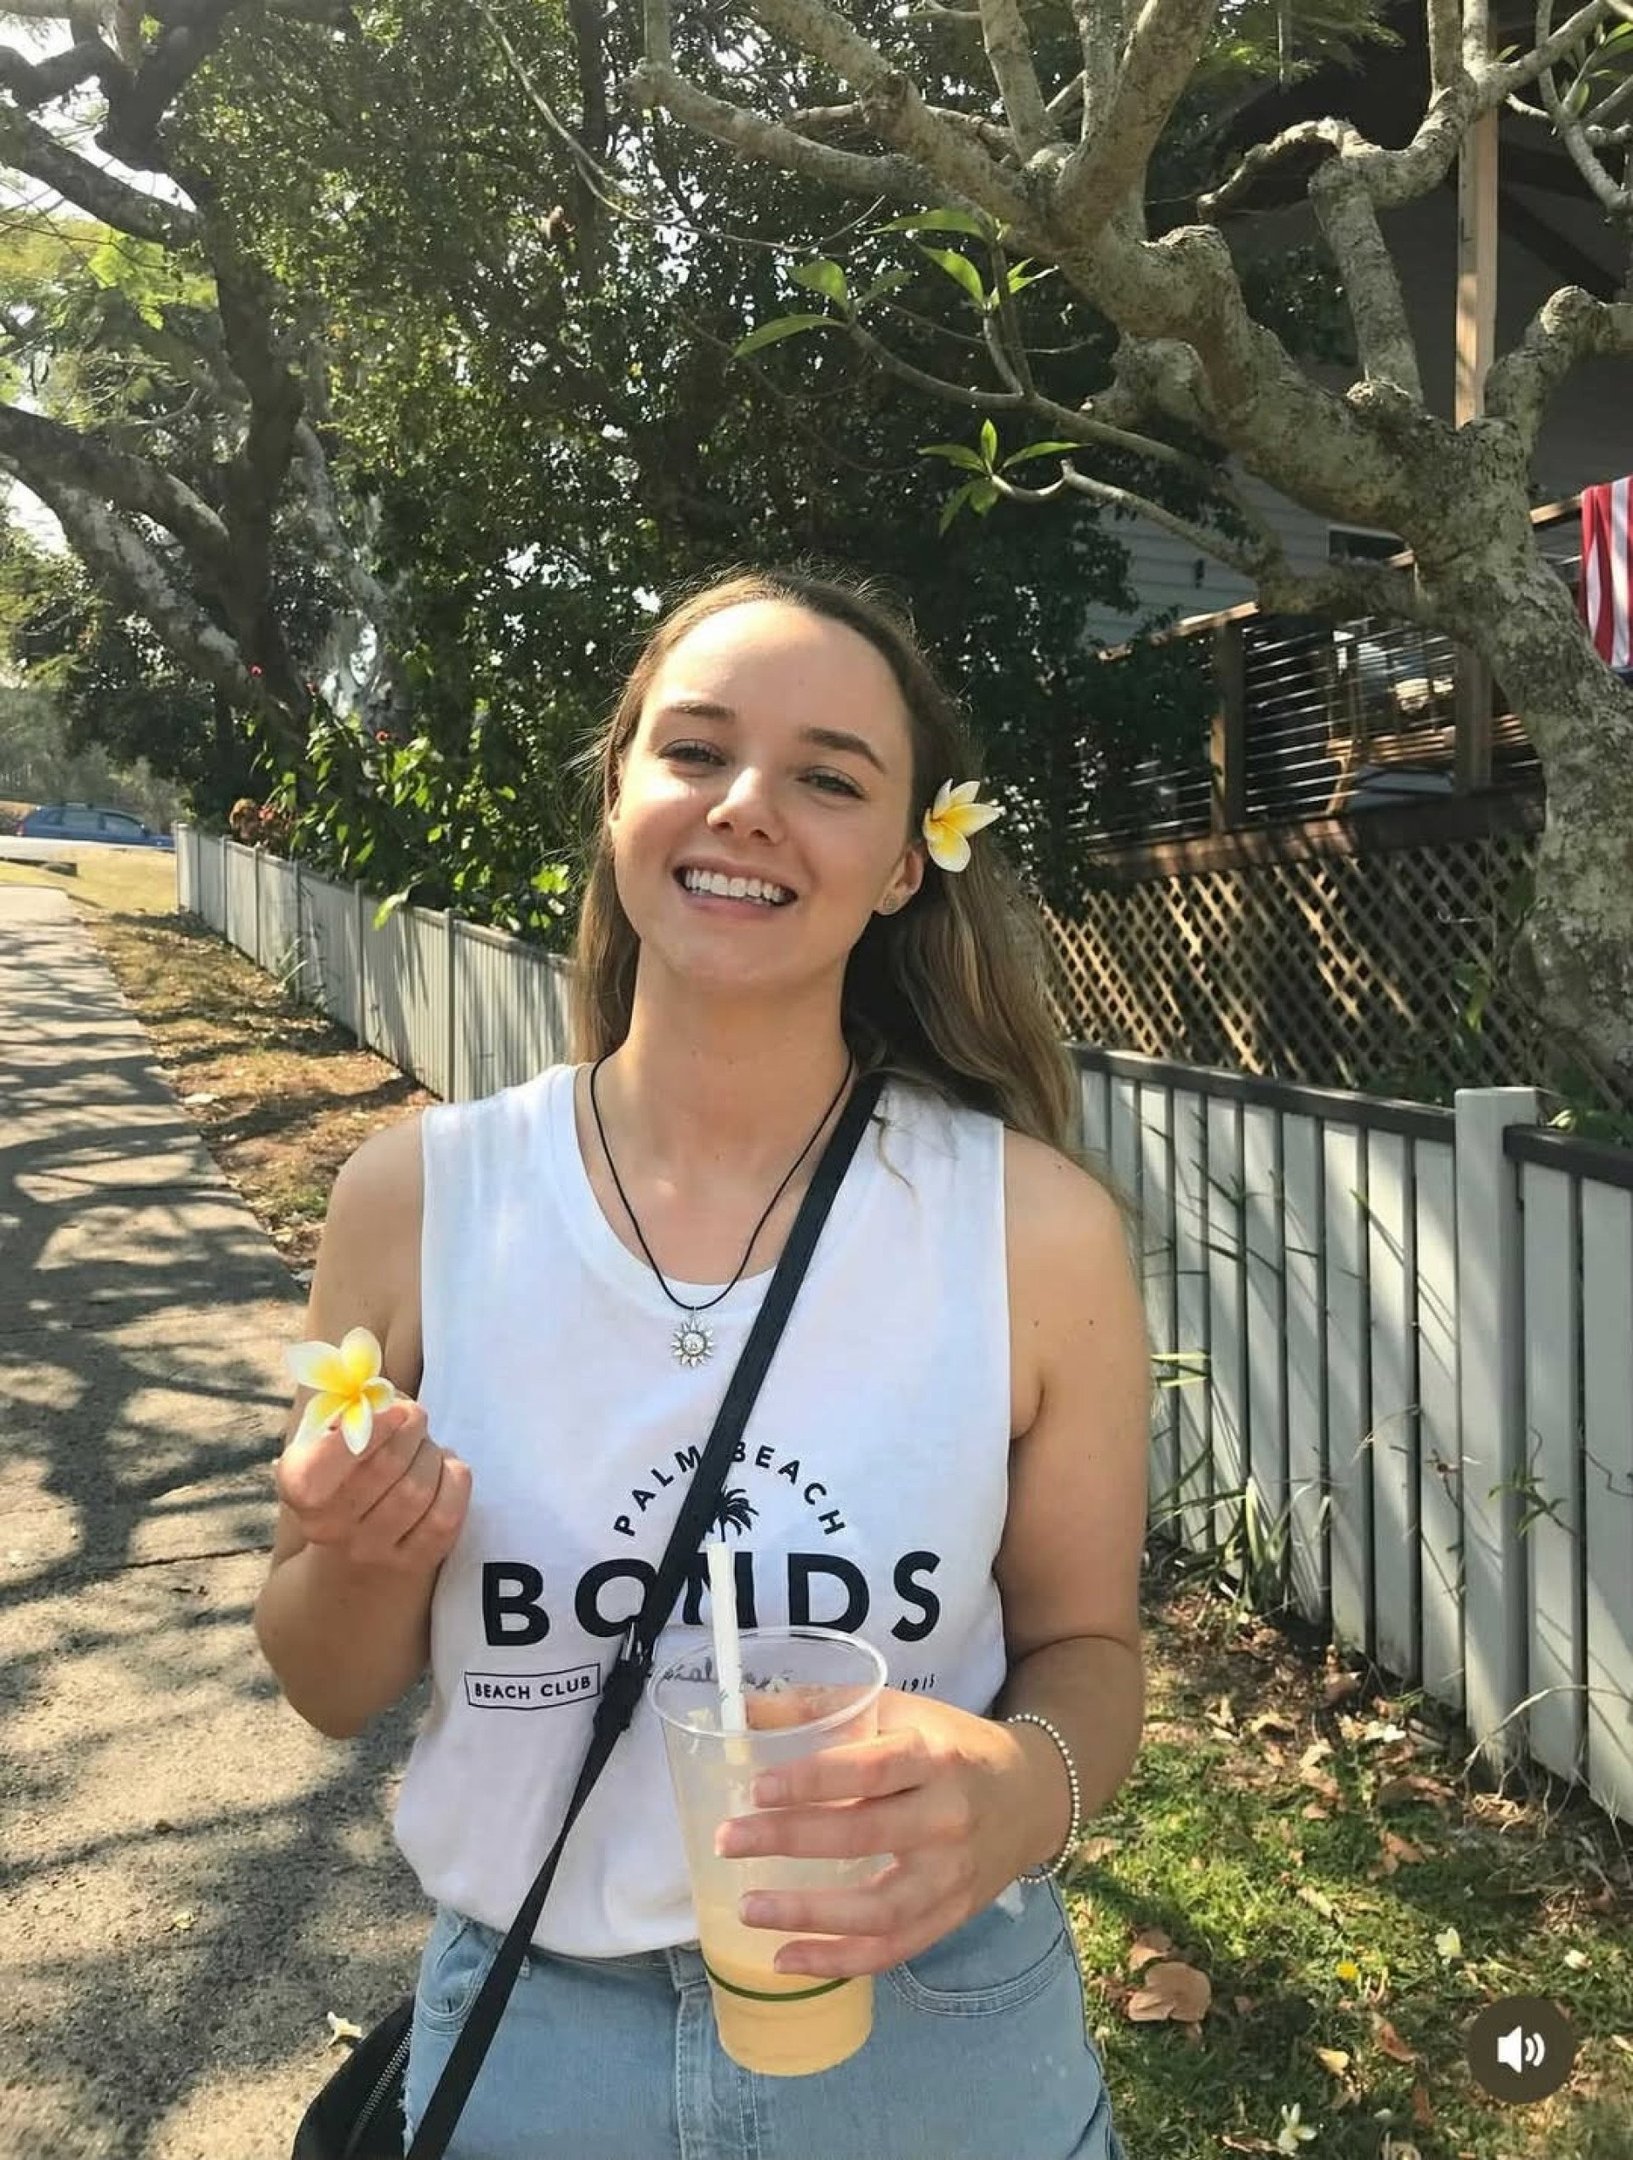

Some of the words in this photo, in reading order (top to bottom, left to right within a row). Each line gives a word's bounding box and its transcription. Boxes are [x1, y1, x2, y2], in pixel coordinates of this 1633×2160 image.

[612, 1444, 701, 1537] PALM
[730, 1440, 847, 1535] BEACH
[474, 1682, 531, 1700] BEACH
[540, 1675, 592, 1698] CLUB
